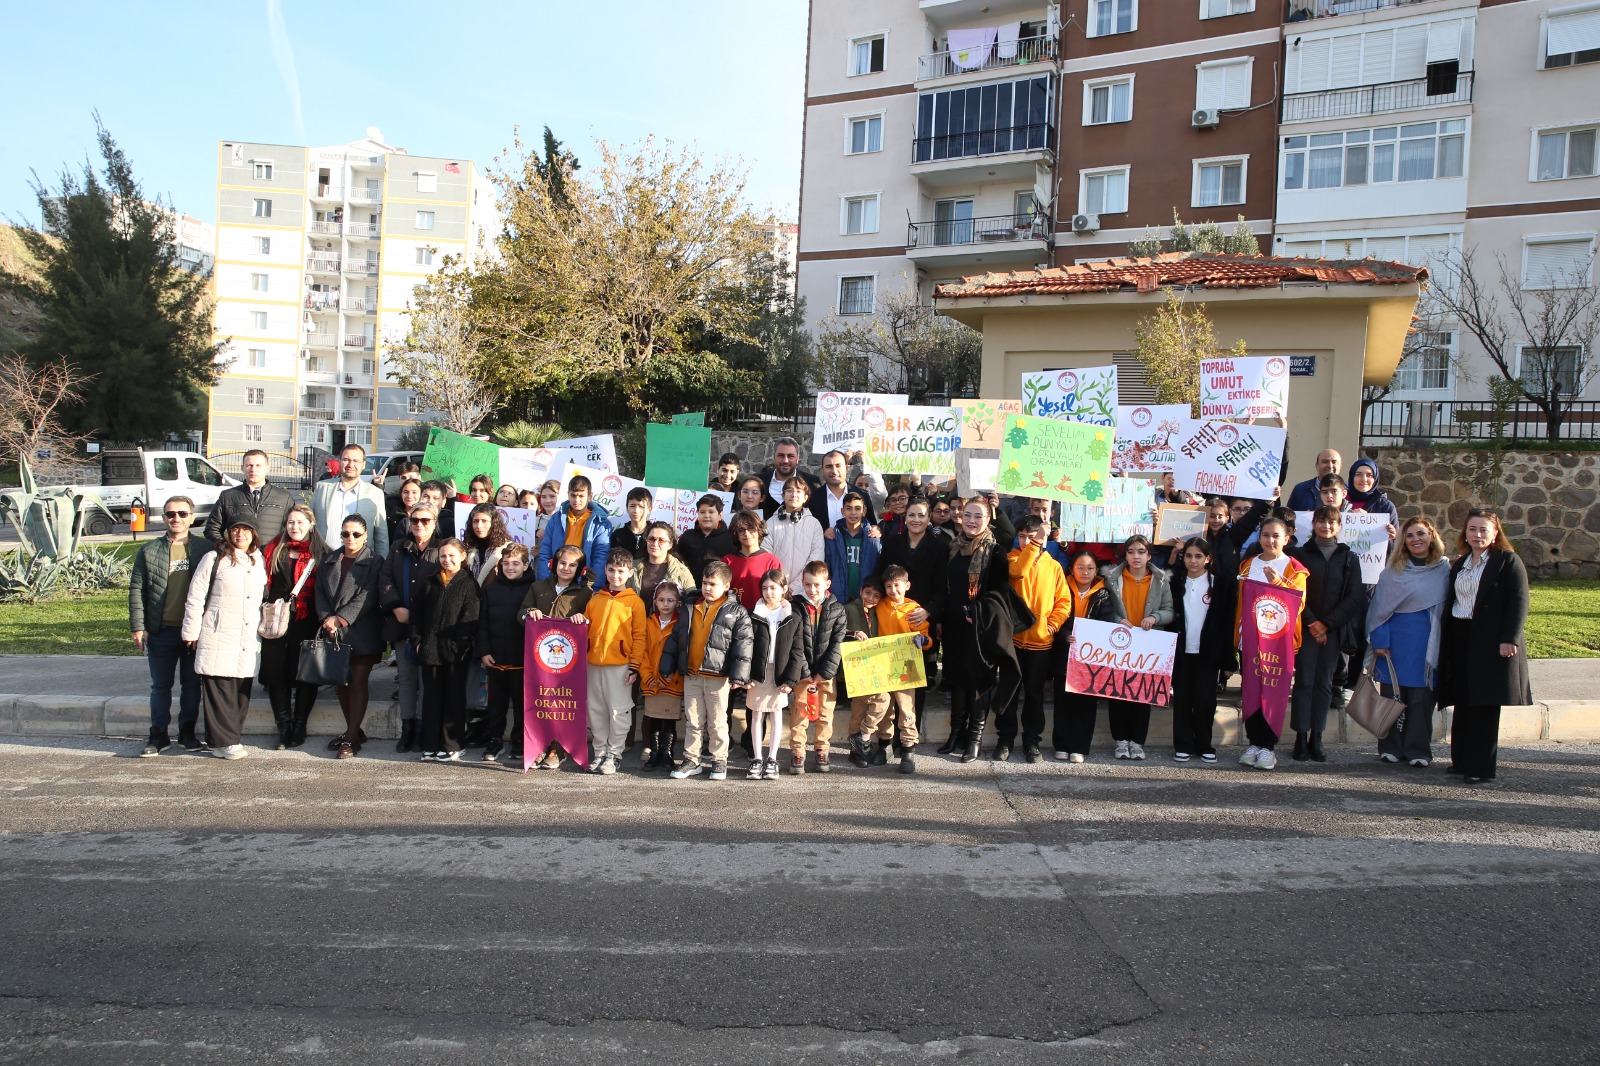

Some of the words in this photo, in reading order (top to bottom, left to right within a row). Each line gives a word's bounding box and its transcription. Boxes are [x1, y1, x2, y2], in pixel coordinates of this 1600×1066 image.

[1202, 359, 1235, 374] TOPRAĞA
[1211, 376, 1243, 390] UMUT
[1228, 389, 1260, 400] EKTİKÇE
[998, 402, 1019, 412] AĞAÇ
[1038, 393, 1075, 416] Yeşil
[1202, 404, 1234, 416] DÜNYA
[886, 417, 911, 432] BİR
[917, 417, 954, 433] AĞAÇ
[872, 436, 894, 452] BİN
[897, 435, 962, 452] GÖLGEDİR
[1149, 452, 1176, 462] OLMA
[1358, 554, 1382, 564] MAN
[1080, 642, 1163, 671] ORMANI
[539, 686, 572, 696] İZMİR
[1082, 663, 1170, 707] YAKMA
[534, 698, 578, 709] ORANTI
[536, 710, 575, 720] OKULU
